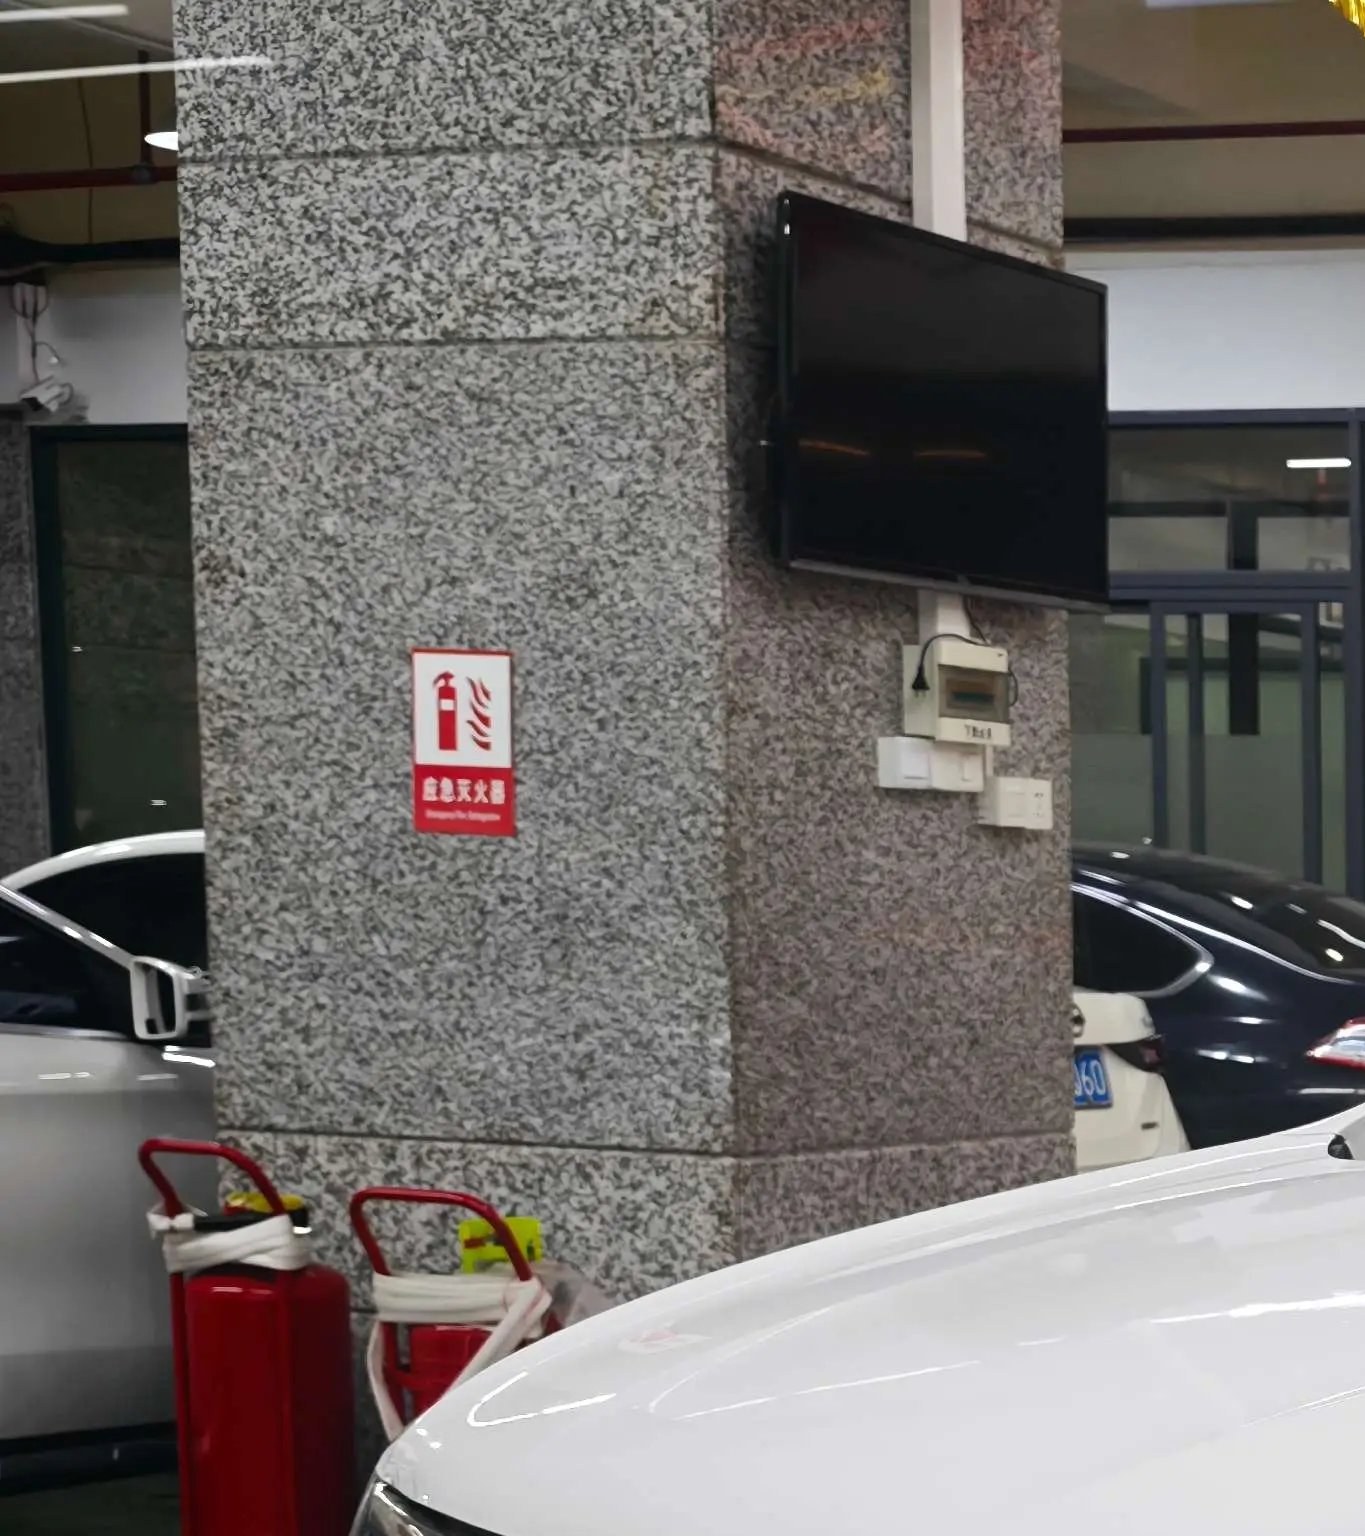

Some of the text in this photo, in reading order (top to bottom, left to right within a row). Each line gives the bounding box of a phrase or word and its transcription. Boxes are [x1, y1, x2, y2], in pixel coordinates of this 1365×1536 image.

[422, 776, 506, 805] 应急灭火器
